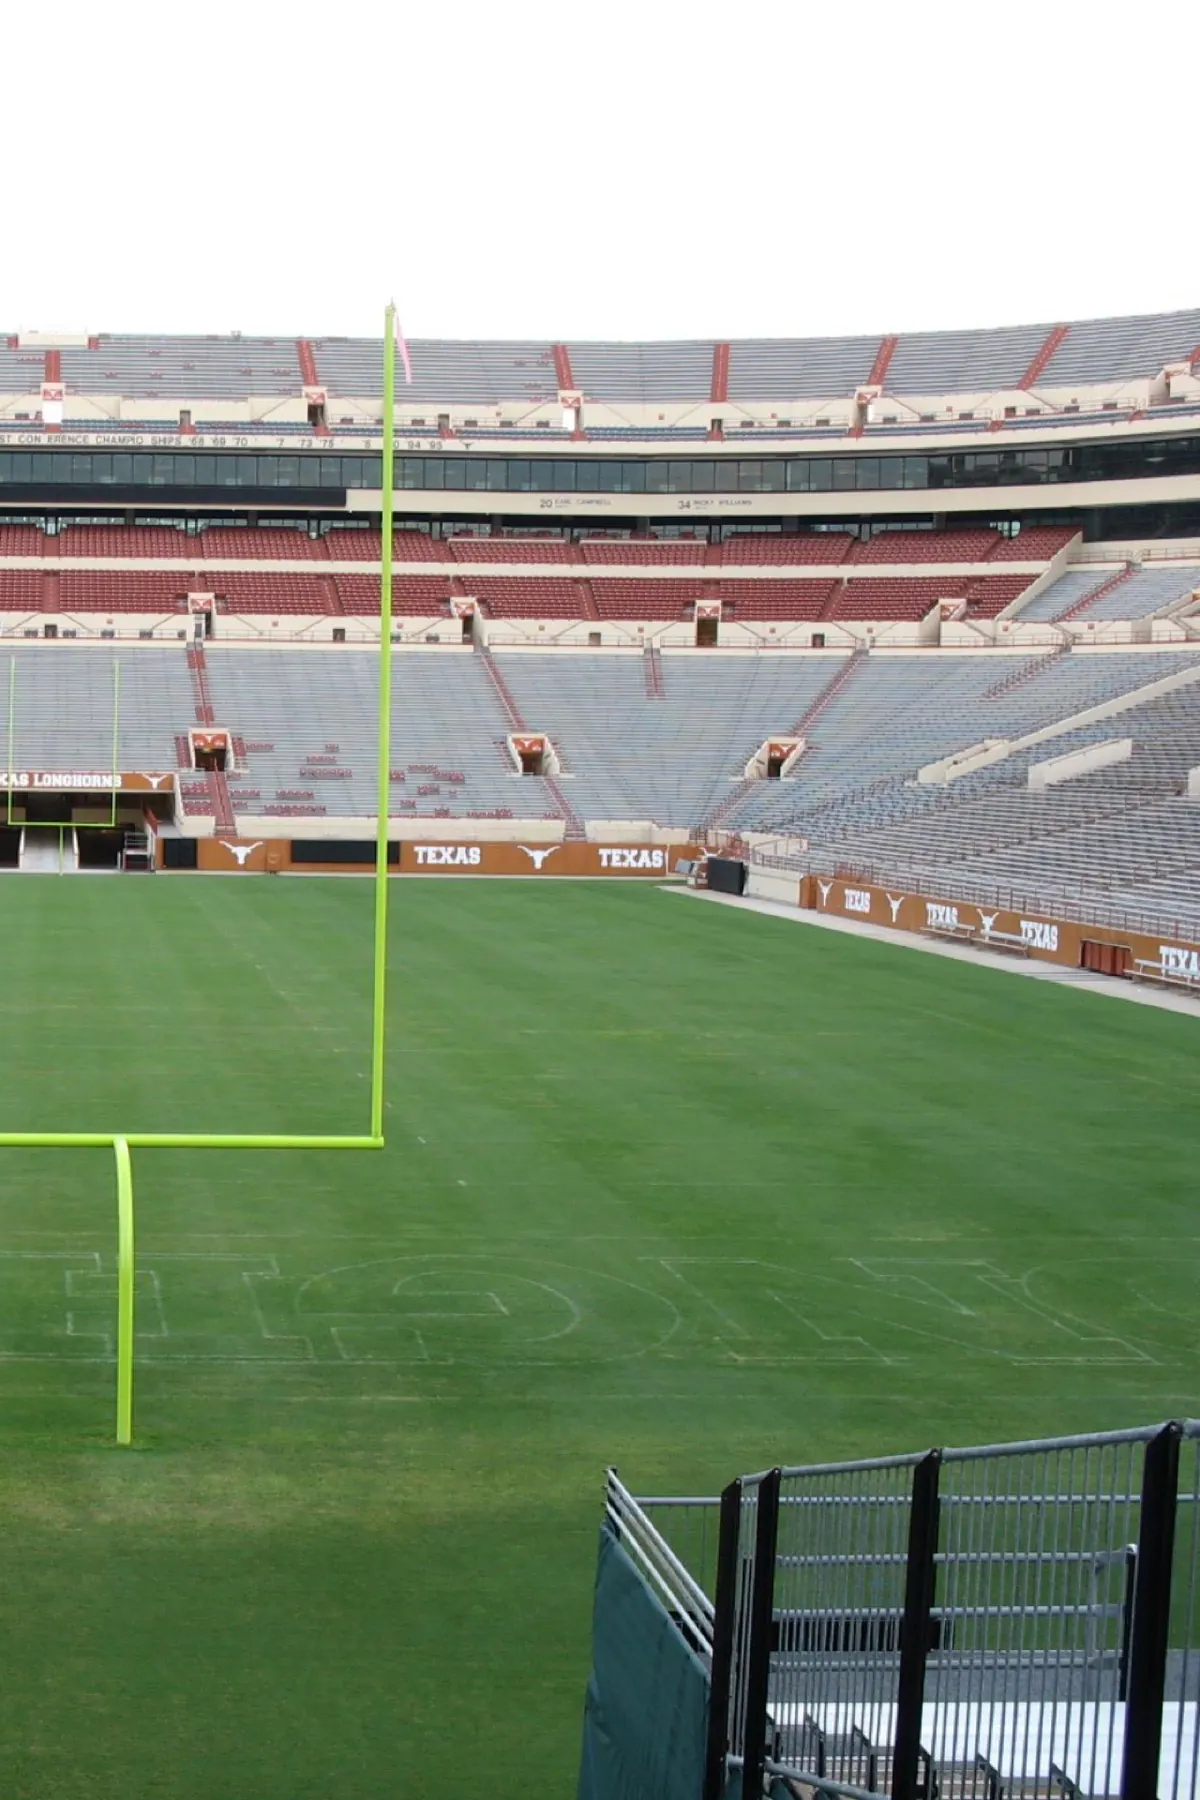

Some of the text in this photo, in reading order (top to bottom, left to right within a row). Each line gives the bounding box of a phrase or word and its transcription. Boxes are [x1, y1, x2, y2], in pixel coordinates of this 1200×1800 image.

[678, 501, 691, 509] 34
[33, 774, 122, 788] LONGHORNS
[413, 846, 481, 864] TEXAS
[599, 849, 663, 868] TEXAS
[845, 888, 871, 914] TEXAS
[926, 902, 959, 931] TEXAS
[1020, 920, 1058, 951] TEXAS
